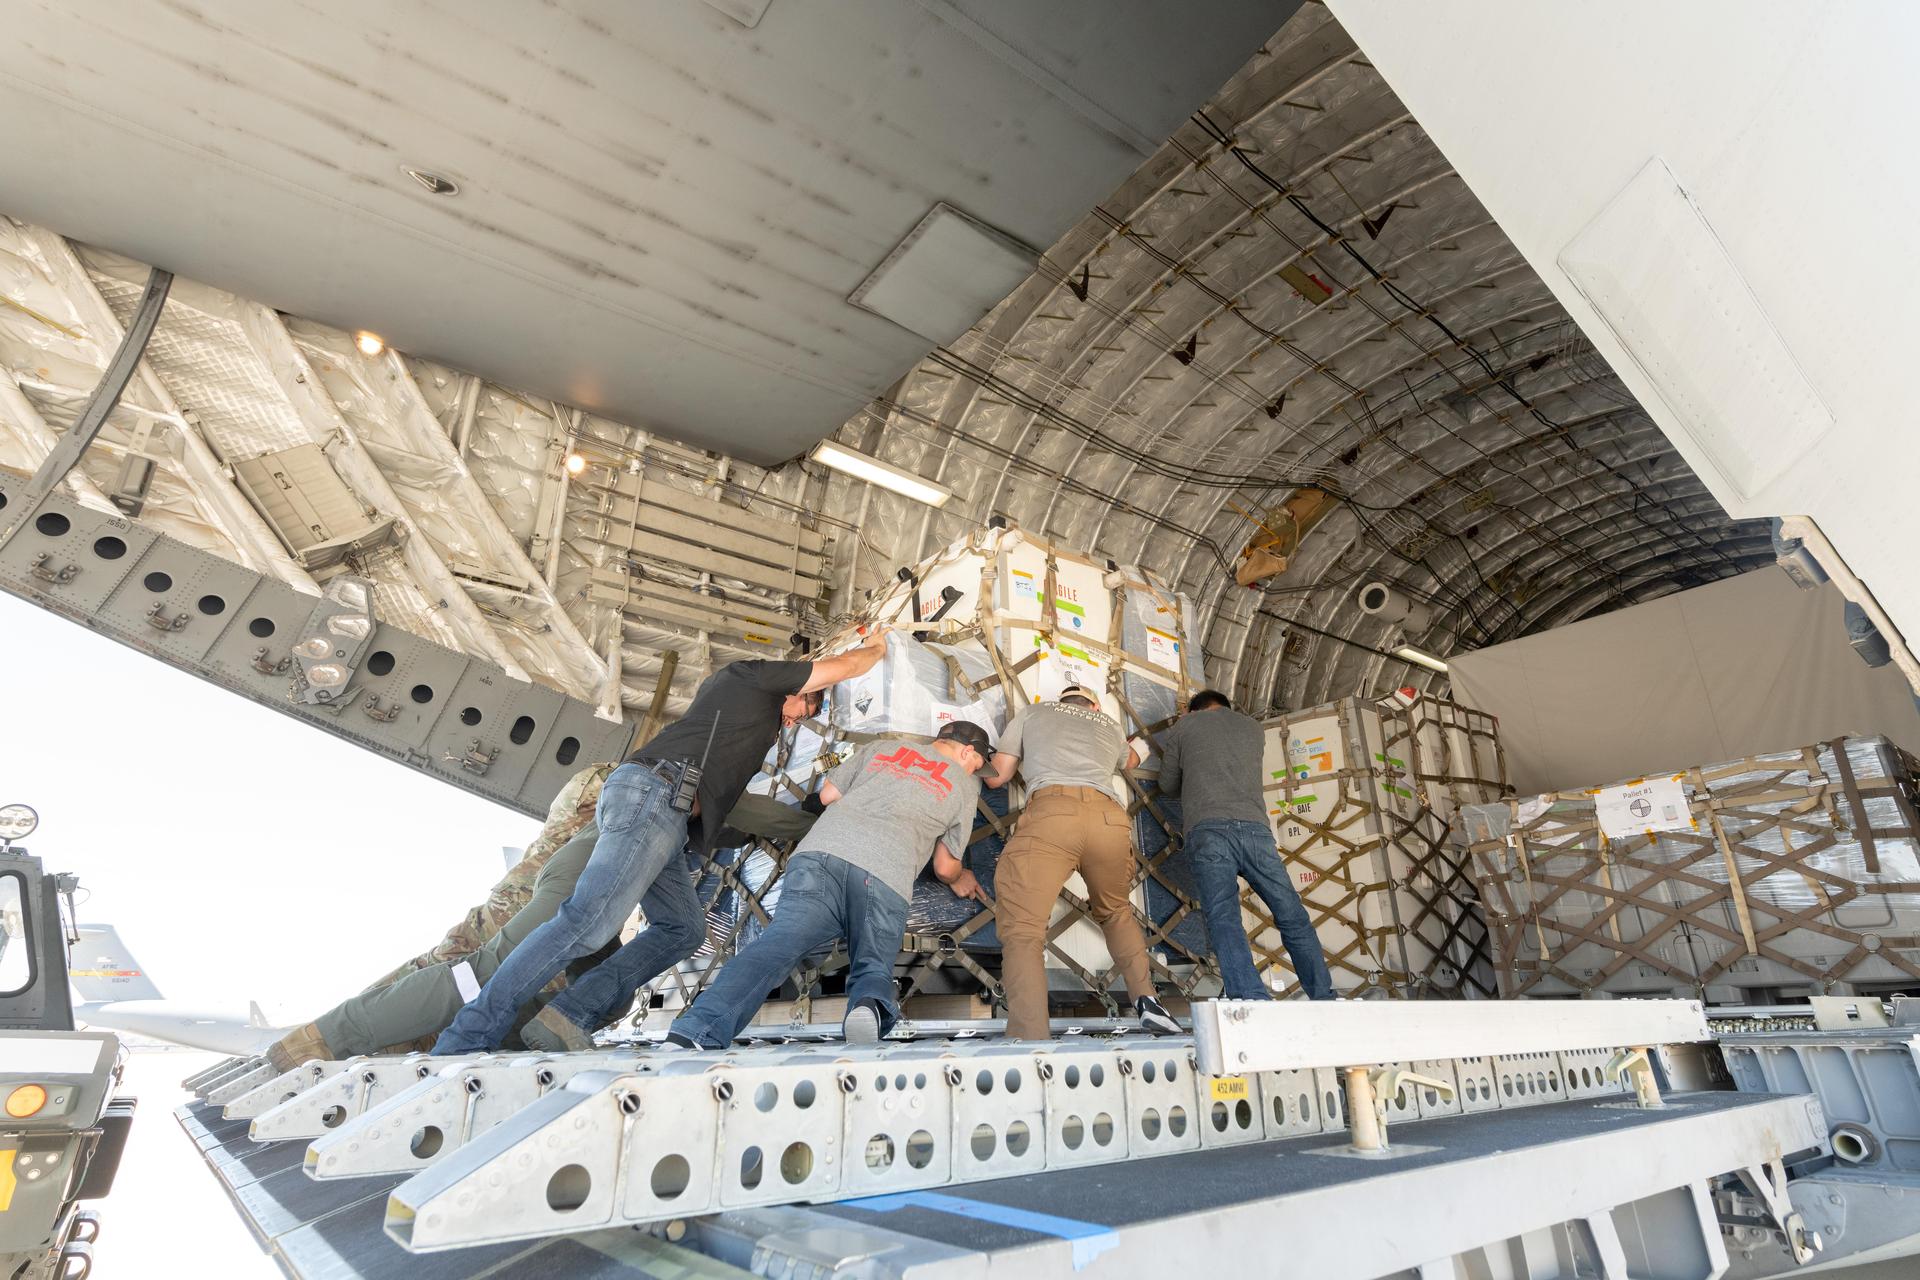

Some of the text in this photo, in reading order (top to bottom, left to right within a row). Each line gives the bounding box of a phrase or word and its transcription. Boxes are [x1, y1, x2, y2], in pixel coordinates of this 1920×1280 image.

[106, 518, 126, 530] 1550
[936, 711, 956, 721] JPL
[1054, 706, 1108, 728] MATTERS
[873, 746, 953, 792] JPL
[1622, 786, 1653, 799] Pallet #1
[1217, 1082, 1243, 1094] 452 AMW
